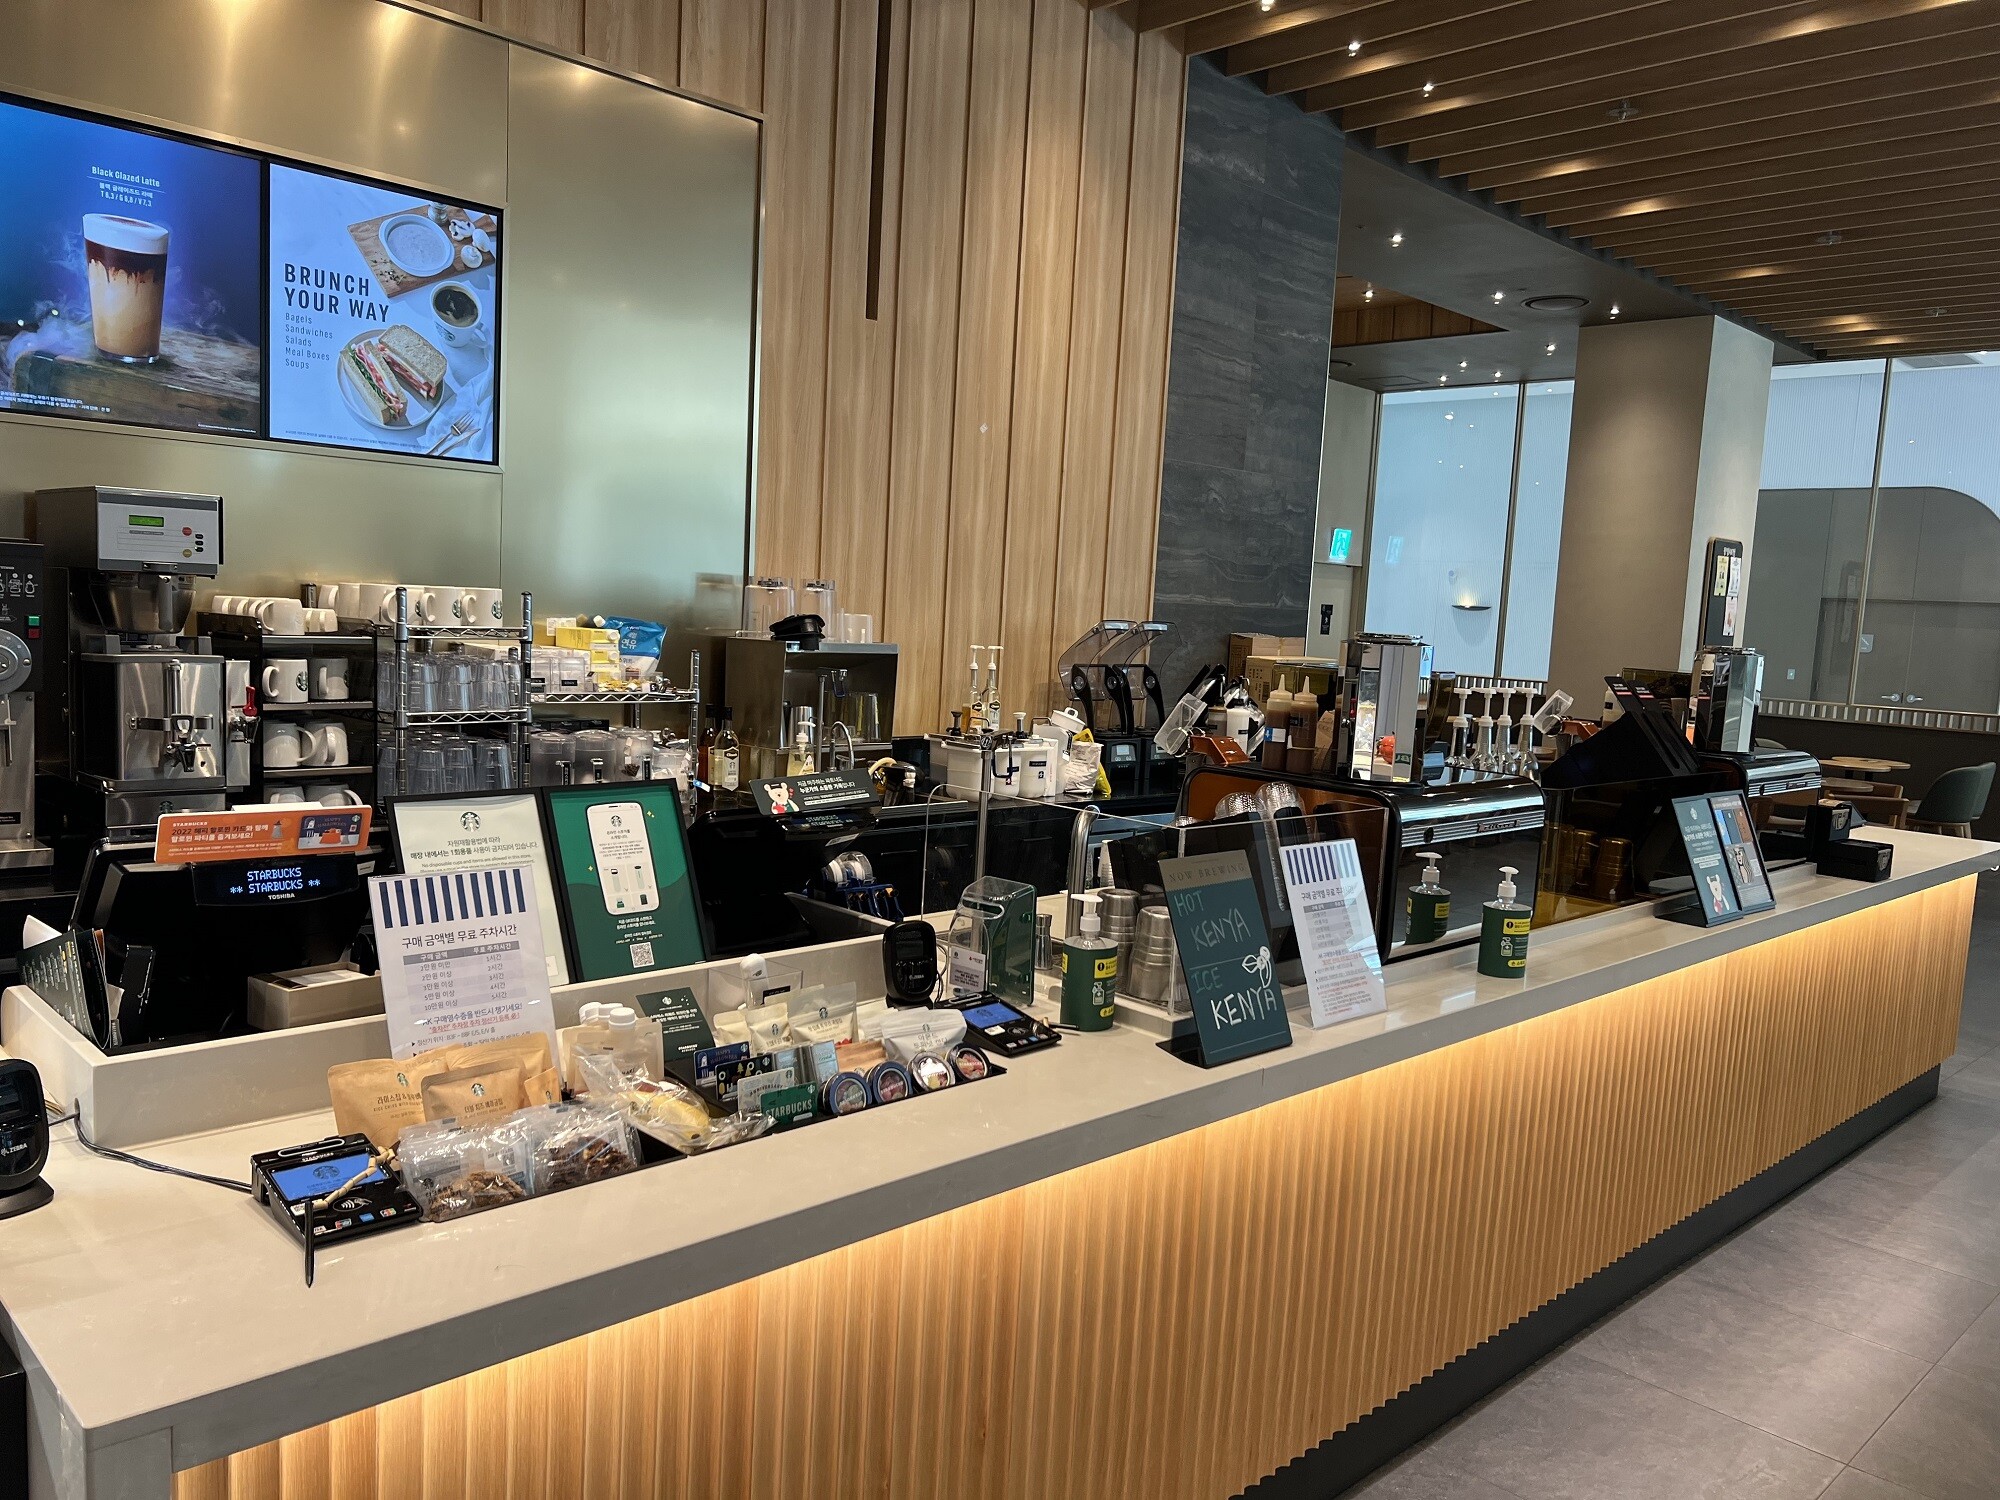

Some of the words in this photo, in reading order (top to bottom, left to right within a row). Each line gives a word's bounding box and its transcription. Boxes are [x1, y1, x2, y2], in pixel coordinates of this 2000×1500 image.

[91, 166, 114, 178] Black
[115, 170, 140, 183] Glazed
[141, 176, 160, 188] Latte
[284, 263, 369, 297] BRUNCH
[284, 287, 339, 315] YOUR
[349, 298, 389, 323] WAY
[285, 312, 312, 324] Bagels
[285, 324, 333, 339] Sandwiches
[285, 336, 312, 347] Salads
[285, 347, 304, 357] Meal
[306, 350, 330, 361] Boxes
[285, 358, 310, 370] Soups
[621, 638, 637, 650] 연유
[194, 834, 215, 842] 파티를
[217, 832, 253, 840] 즐겨보세요!
[424, 850, 449, 858] 내에서는
[450, 847, 472, 856] 1회용품
[491, 844, 514, 852] 금지되어
[247, 867, 302, 882] STARBUCKS
[1169, 869, 1192, 883] NOW
[1199, 863, 1245, 879] BREWING
[248, 879, 303, 894] STARBUCKS
[1173, 890, 1204, 918] HOT
[402, 936, 423, 949] 구매
[425, 931, 455, 947] 금액별
[458, 929, 477, 942] 무료
[479, 924, 517, 939] 주차시간
[1190, 907, 1251, 952] KENYA
[420, 953, 433, 962] 구매
[434, 951, 448, 960] 금액
[487, 943, 511, 952] 주차시간
[420, 963, 437, 972] 2만원
[486, 953, 502, 962] 1시간
[422, 972, 438, 981] 2만원
[488, 963, 503, 971] 2시간
[424, 982, 440, 991] 3만원
[489, 973, 504, 981] 3시간
[1191, 966, 1224, 994] ICE
[425, 992, 441, 1001] 5만원
[490, 982, 506, 990] 4시간
[425, 1002, 443, 1011] 10만원
[492, 992, 507, 1000] 5시간
[1210, 986, 1278, 1030] KENYA
[434, 1011, 473, 1024] 구매영수증을
[475, 1007, 494, 1018] 반드시
[495, 1003, 523, 1015] 챙기세요!
[377, 1093, 402, 1104] 라이스칩
[749, 1084, 784, 1097] ANNIVERSARY
[765, 1099, 812, 1120] STARBUCKS
